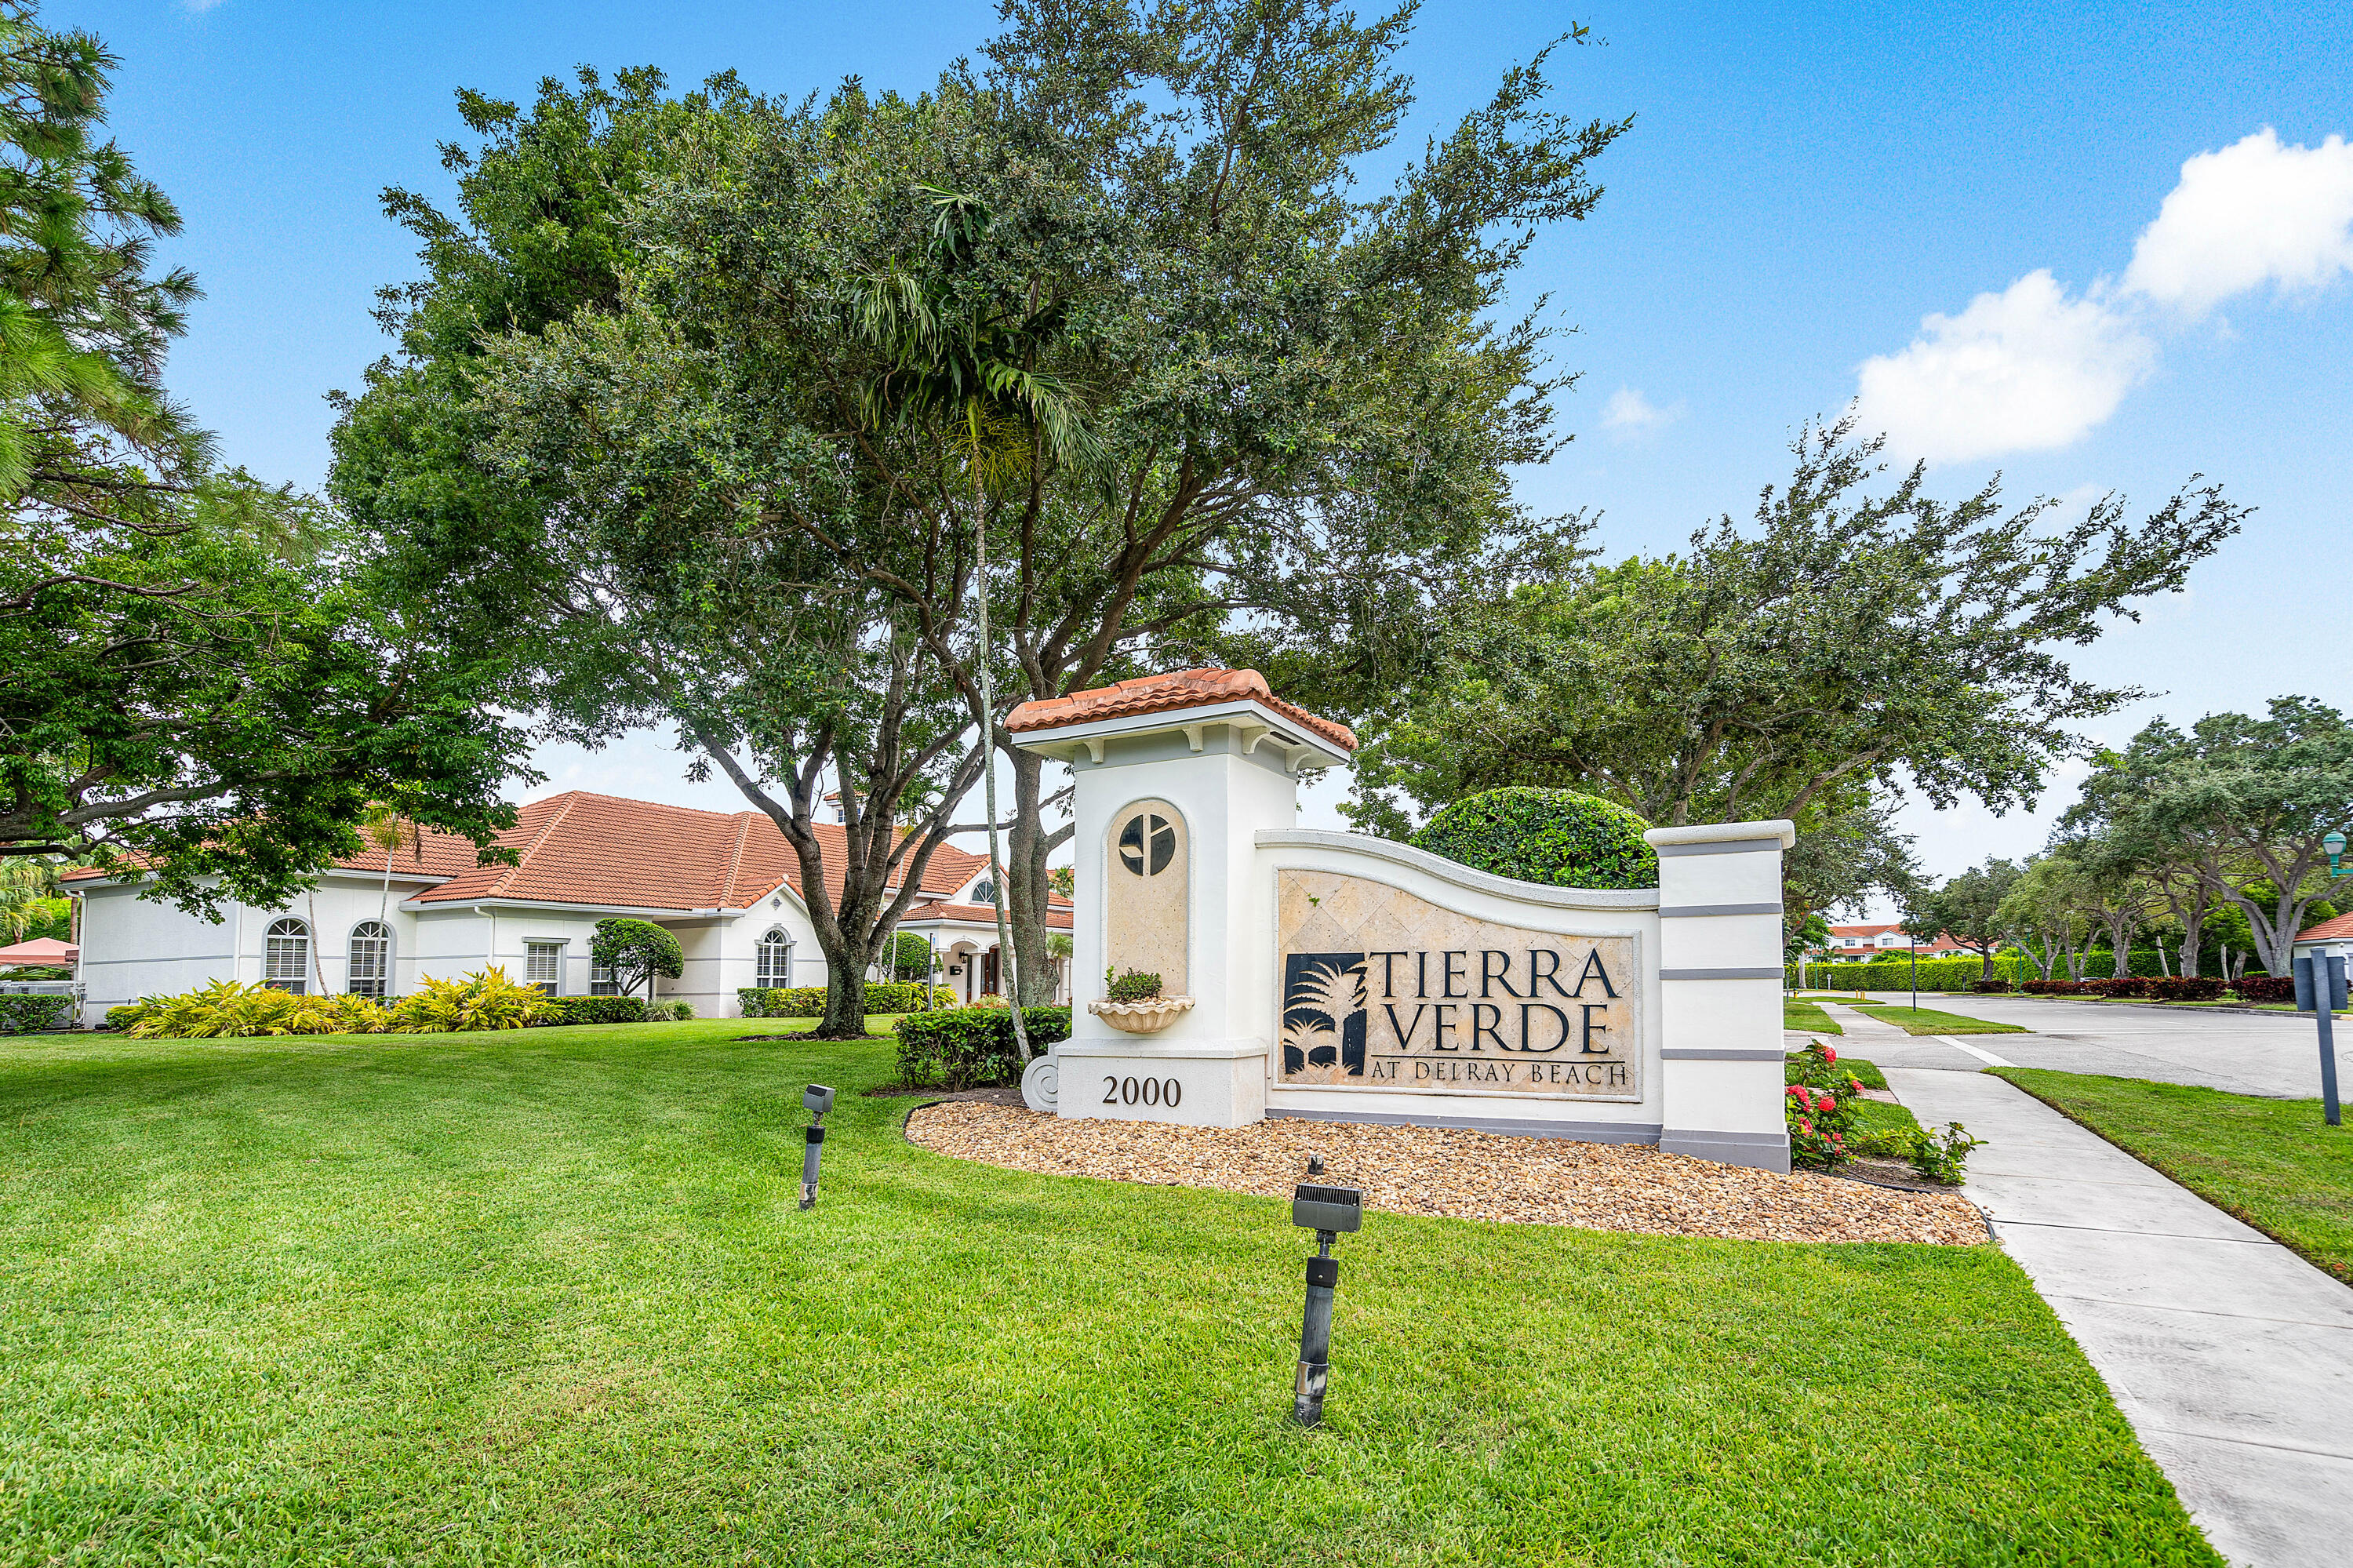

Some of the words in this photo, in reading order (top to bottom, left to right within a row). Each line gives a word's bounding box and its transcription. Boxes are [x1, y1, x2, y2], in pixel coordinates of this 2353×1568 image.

[1369, 948, 1622, 999] TIERRA
[1380, 1002, 1609, 1054] VERDE
[1102, 1075, 1182, 1108] 2000
[1372, 1060, 1400, 1079] AT
[1415, 1062, 1516, 1082] DELRAY
[1532, 1064, 1627, 1086] BEACH
